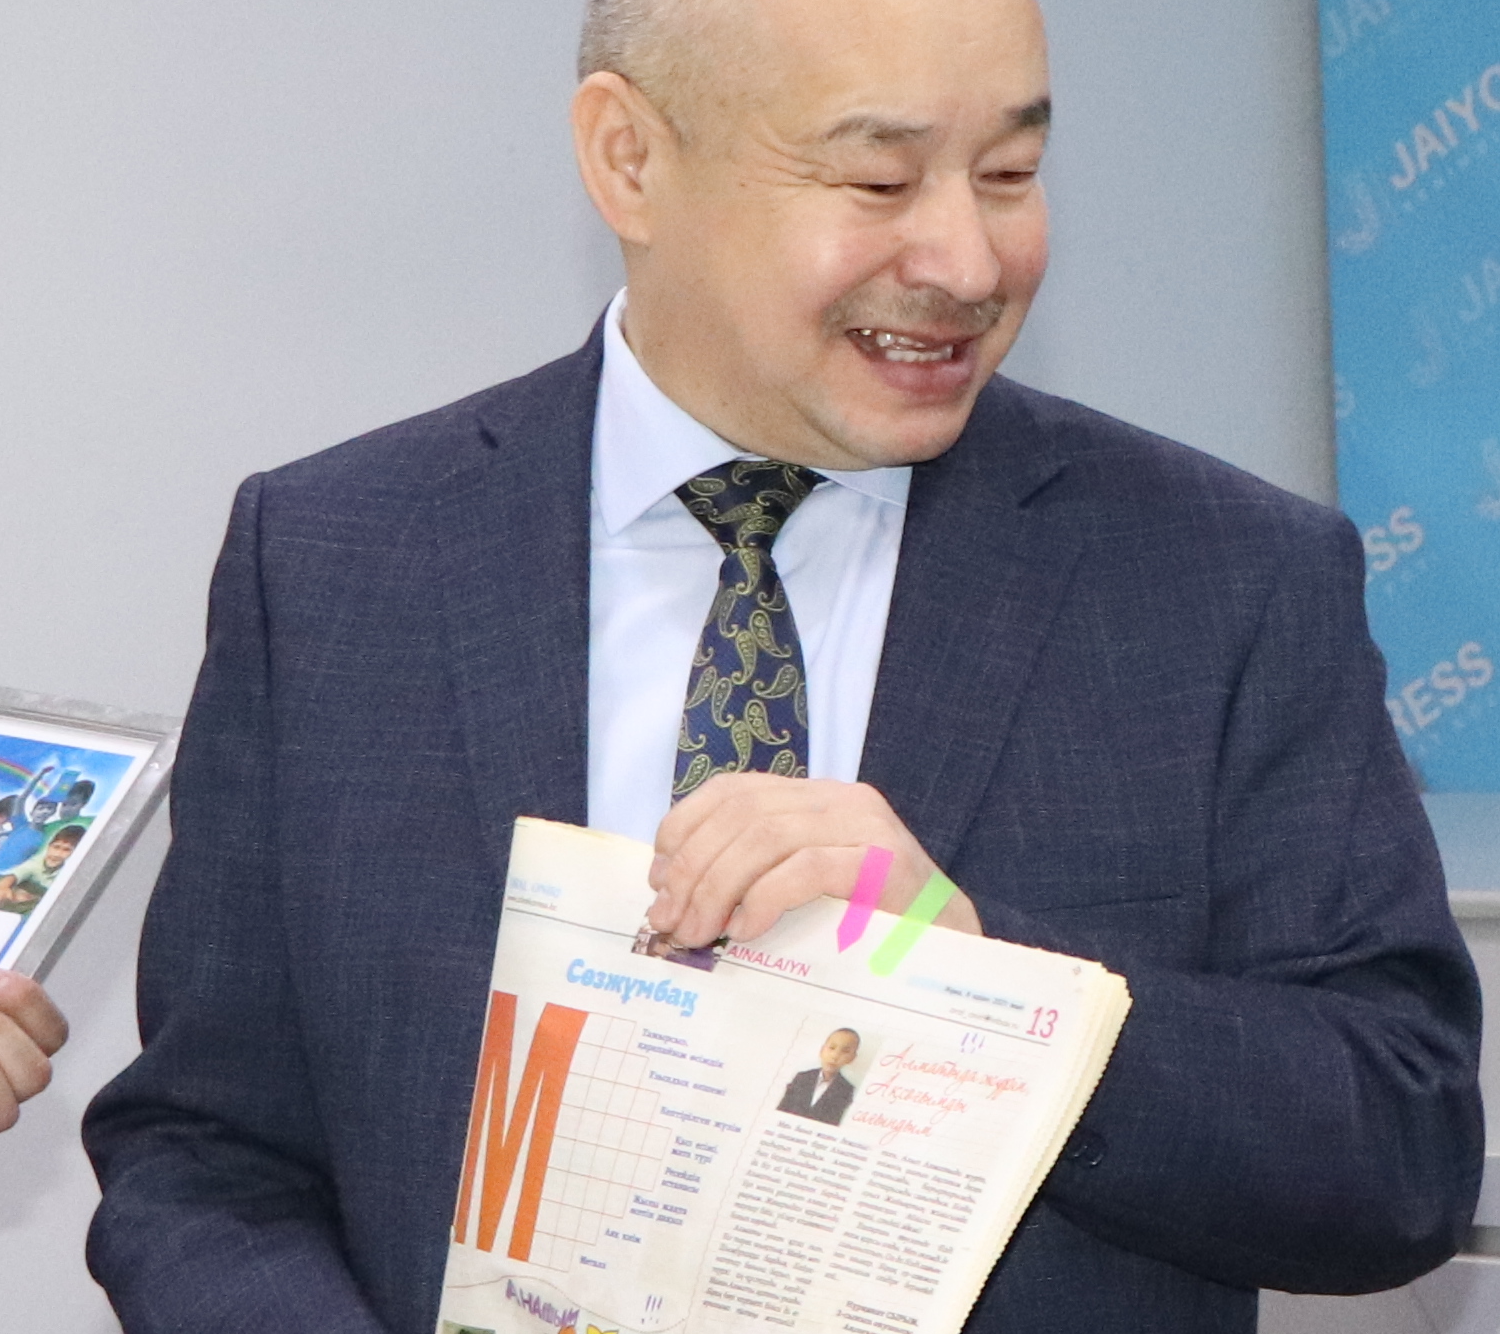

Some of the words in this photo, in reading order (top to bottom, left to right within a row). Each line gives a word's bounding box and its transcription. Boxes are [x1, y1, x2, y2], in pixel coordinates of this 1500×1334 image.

[1384, 641, 1493, 740] RESS
[566, 958, 698, 1018] Сөзжұмбақ
[1026, 1006, 1059, 1039] 13
